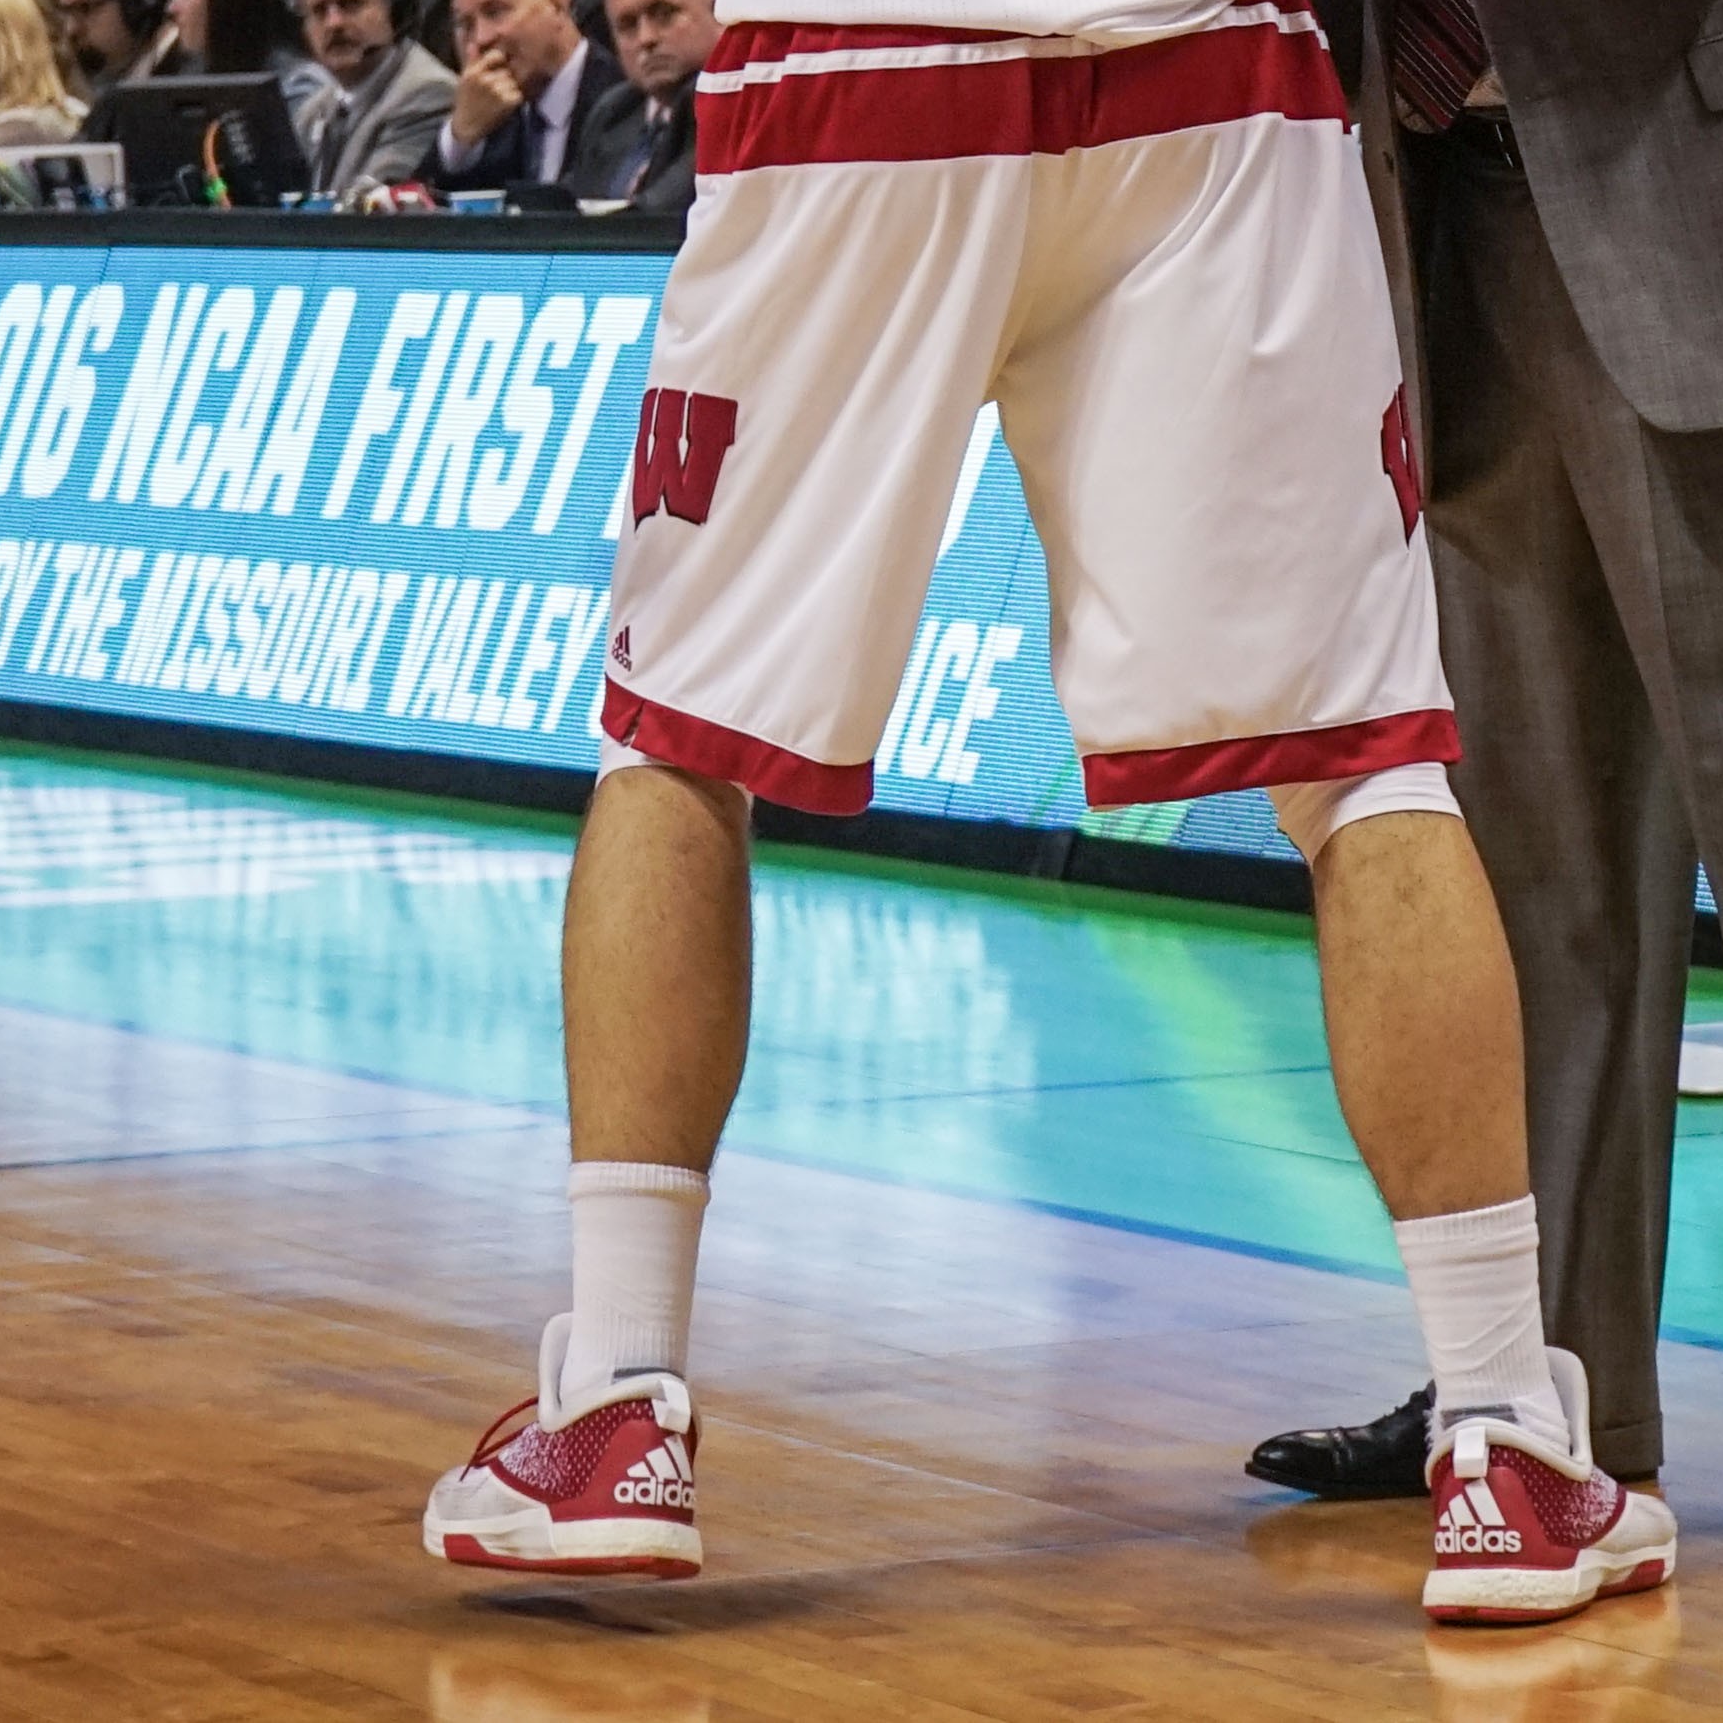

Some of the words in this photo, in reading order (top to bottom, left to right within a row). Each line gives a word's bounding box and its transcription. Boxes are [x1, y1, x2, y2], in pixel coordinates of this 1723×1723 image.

[89, 281, 357, 519] NCAA
[322, 289, 652, 536] FIRST
[632, 387, 739, 533] W
[26, 541, 144, 683] THE
[136, 551, 410, 712] MISSOURI
[386, 574, 613, 734] VALLEY
[613, 1475, 695, 1510] adida
[1434, 1524, 1522, 1554] adidas
